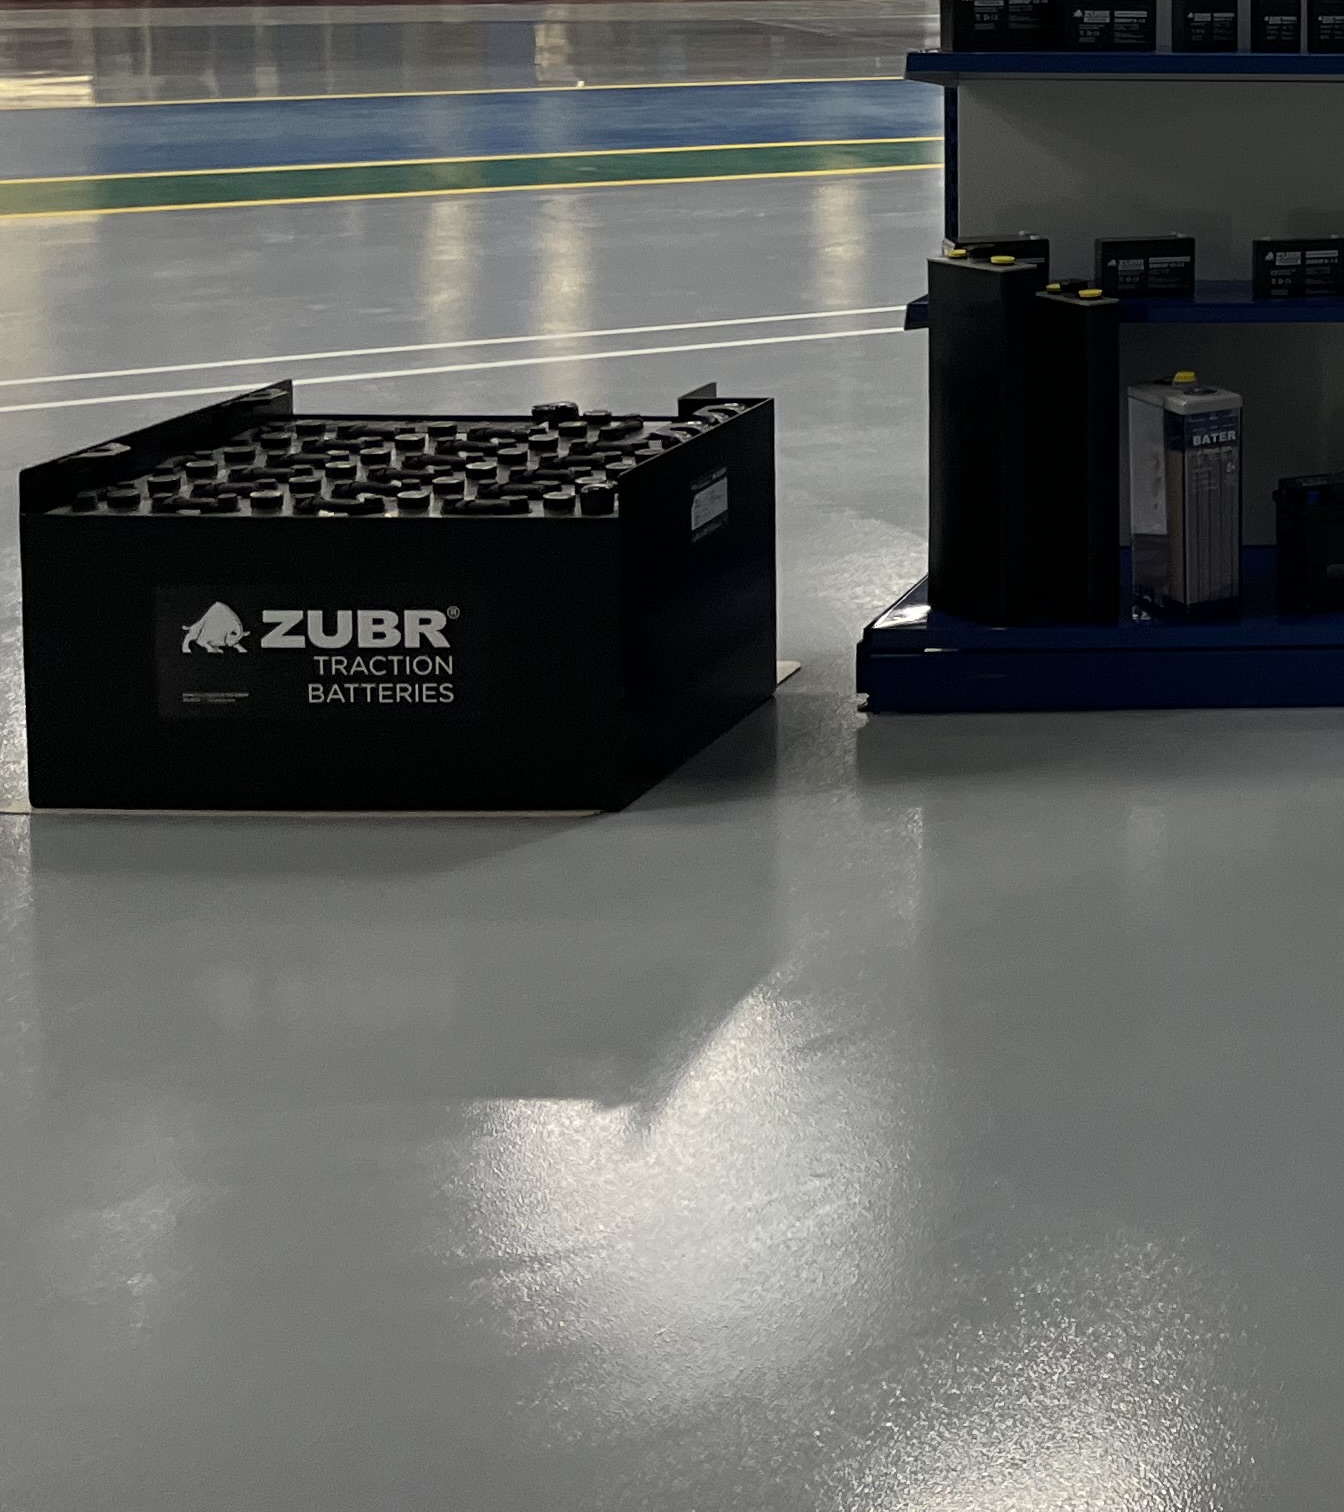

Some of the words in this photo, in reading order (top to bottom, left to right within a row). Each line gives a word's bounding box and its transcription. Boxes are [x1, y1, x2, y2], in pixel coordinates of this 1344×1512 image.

[1193, 430, 1237, 447] BATER
[313, 654, 454, 676] TRACTION
[307, 682, 455, 704] BATTERIES
